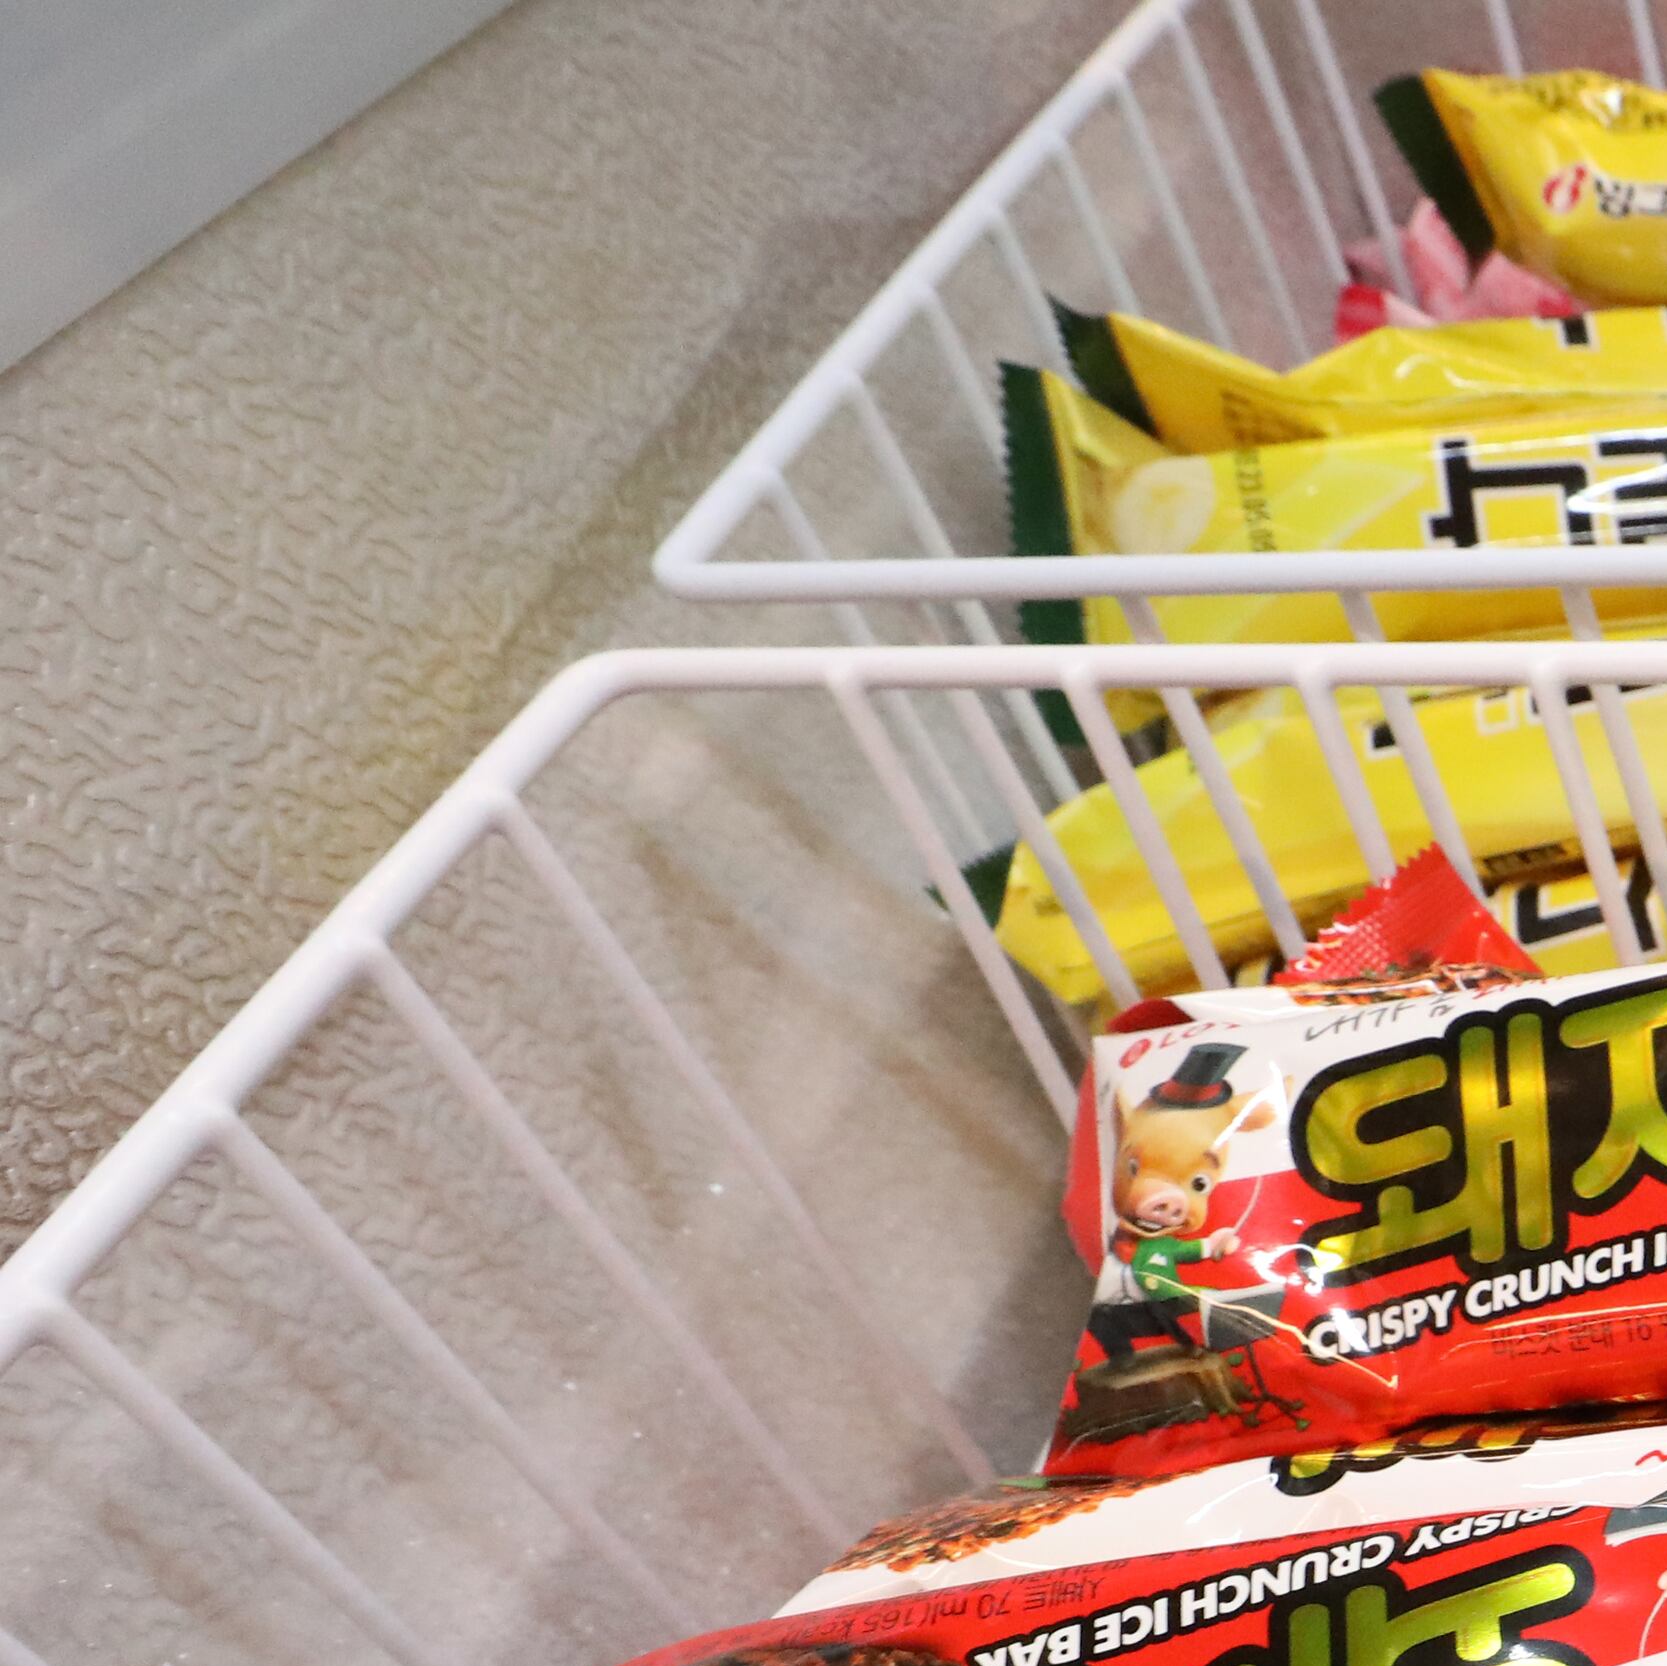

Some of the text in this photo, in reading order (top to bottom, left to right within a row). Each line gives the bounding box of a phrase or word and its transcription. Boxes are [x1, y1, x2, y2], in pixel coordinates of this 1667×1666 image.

[1311, 1290, 1456, 1362] CRISPY
[1465, 1239, 1646, 1328] CRUNCH
[1405, 1500, 1589, 1560] CRISPY
[1166, 1533, 1394, 1625] CRUNCH
[1091, 1600, 1163, 1659] ICE
